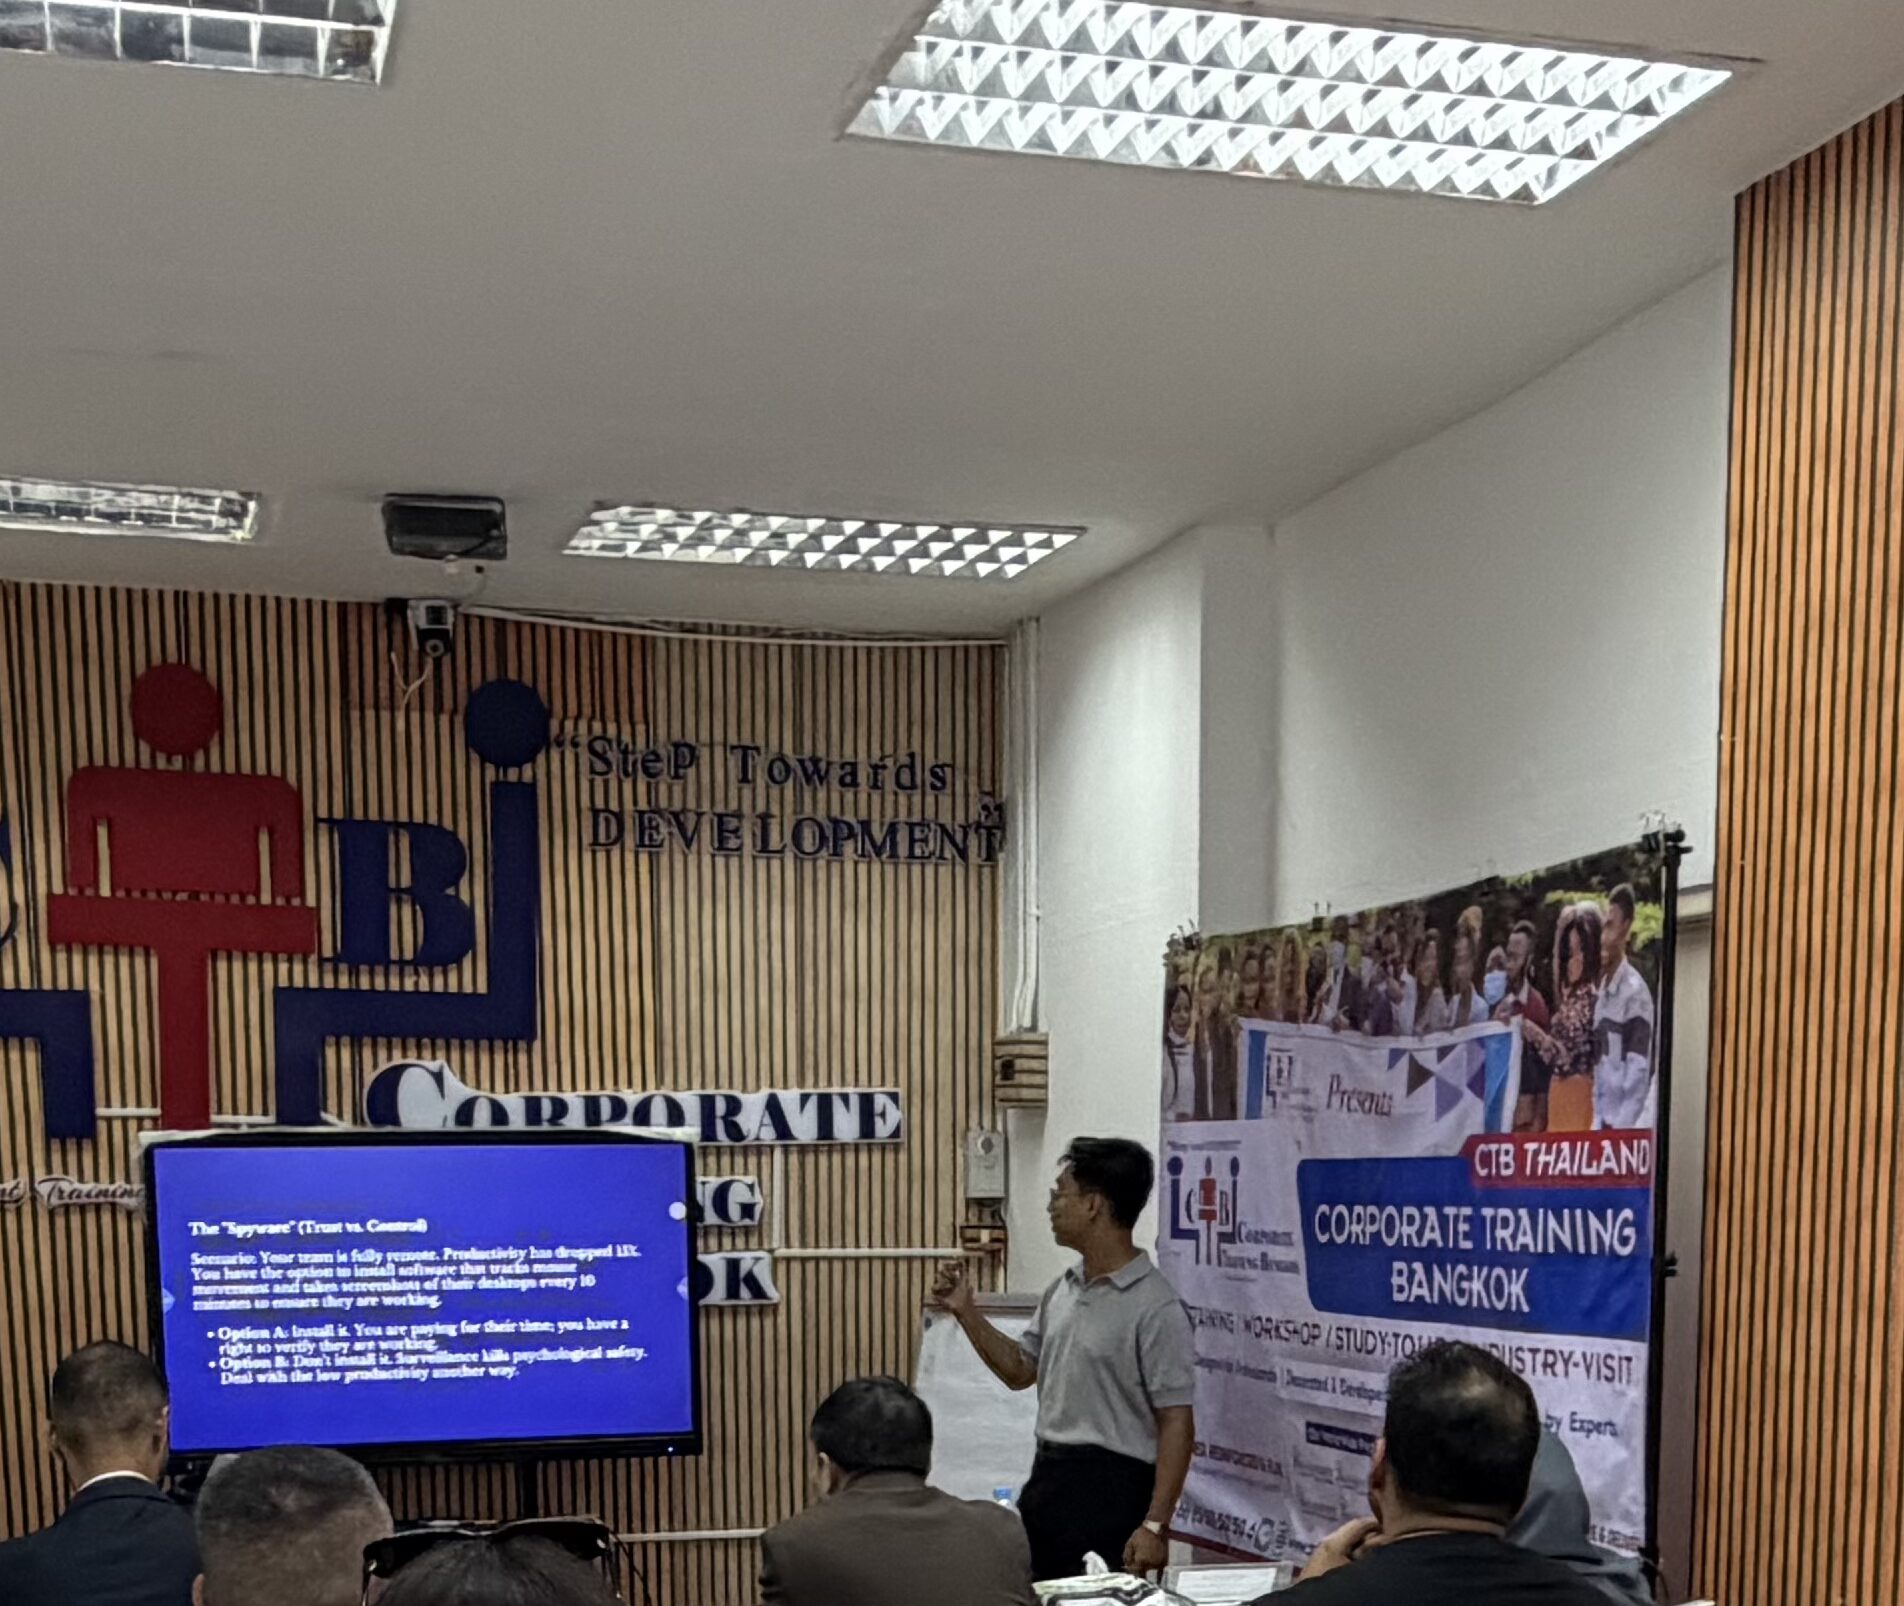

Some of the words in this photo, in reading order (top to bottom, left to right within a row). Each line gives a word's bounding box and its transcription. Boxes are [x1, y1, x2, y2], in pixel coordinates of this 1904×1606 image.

[731, 744, 953, 791] Towards
[1327, 1073, 1393, 1117] Presents
[1474, 1142, 1515, 1175] CTB
[1524, 1140, 1650, 1177] THAILAND
[188, 1221, 220, 1235] The
[366, 1219, 428, 1233] Control)
[1314, 1203, 1473, 1245] CORPORATE
[1482, 1206, 1637, 1257] TRAINING
[260, 1250, 295, 1264] Your
[297, 1253, 334, 1263] team
[336, 1250, 348, 1262] is
[351, 1249, 383, 1264] fully
[444, 1246, 528, 1263] Productivity
[529, 1246, 552, 1259] has
[555, 1244, 613, 1261] dropped
[191, 1267, 222, 1281] You
[223, 1267, 258, 1280] have
[260, 1267, 285, 1280] the
[287, 1267, 334, 1281] option
[336, 1267, 351, 1277] to
[354, 1264, 396, 1277] install
[398, 1263, 457, 1276] software
[460, 1262, 487, 1274] that
[489, 1261, 530, 1274] tracks
[532, 1263, 577, 1273] mouse
[192, 1284, 270, 1296] movement
[272, 1280, 300, 1294] and
[302, 1279, 339, 1293] takes
[341, 1278, 421, 1292] screenshots
[423, 1277, 438, 1291] of
[441, 1277, 476, 1290] their
[477, 1277, 537, 1292] desktops
[539, 1278, 577, 1291] every
[1391, 1261, 1530, 1312] BANGKOK
[193, 1298, 253, 1311] minutes
[254, 1298, 271, 1309] to
[272, 1298, 320, 1309] ensure
[322, 1295, 354, 1311] they
[356, 1296, 380, 1306] are
[382, 1295, 443, 1309] working.
[218, 1326, 271, 1342] Option
[292, 1324, 334, 1337] Install
[354, 1323, 383, 1337] You
[385, 1325, 408, 1335] are
[410, 1323, 457, 1338] paying
[460, 1319, 482, 1333] for
[483, 1319, 518, 1333] their
[557, 1319, 584, 1334] you
[587, 1318, 618, 1330] have
[620, 1319, 629, 1329] a
[219, 1343, 253, 1358] right
[256, 1343, 272, 1353] to
[274, 1340, 316, 1355] verify
[319, 1340, 350, 1354] they
[353, 1341, 376, 1351] are
[378, 1338, 439, 1353] working.
[219, 1356, 272, 1371] Option
[334, 1353, 376, 1366] install
[482, 1348, 510, 1361] kills
[512, 1346, 603, 1364] psychological
[605, 1344, 649, 1361] safety.
[220, 1371, 254, 1385] Deal
[256, 1372, 288, 1383] with
[290, 1370, 314, 1382] the
[316, 1369, 342, 1381] low
[344, 1367, 430, 1384] productivity
[432, 1366, 485, 1379] another
[488, 1365, 521, 1379] way.
